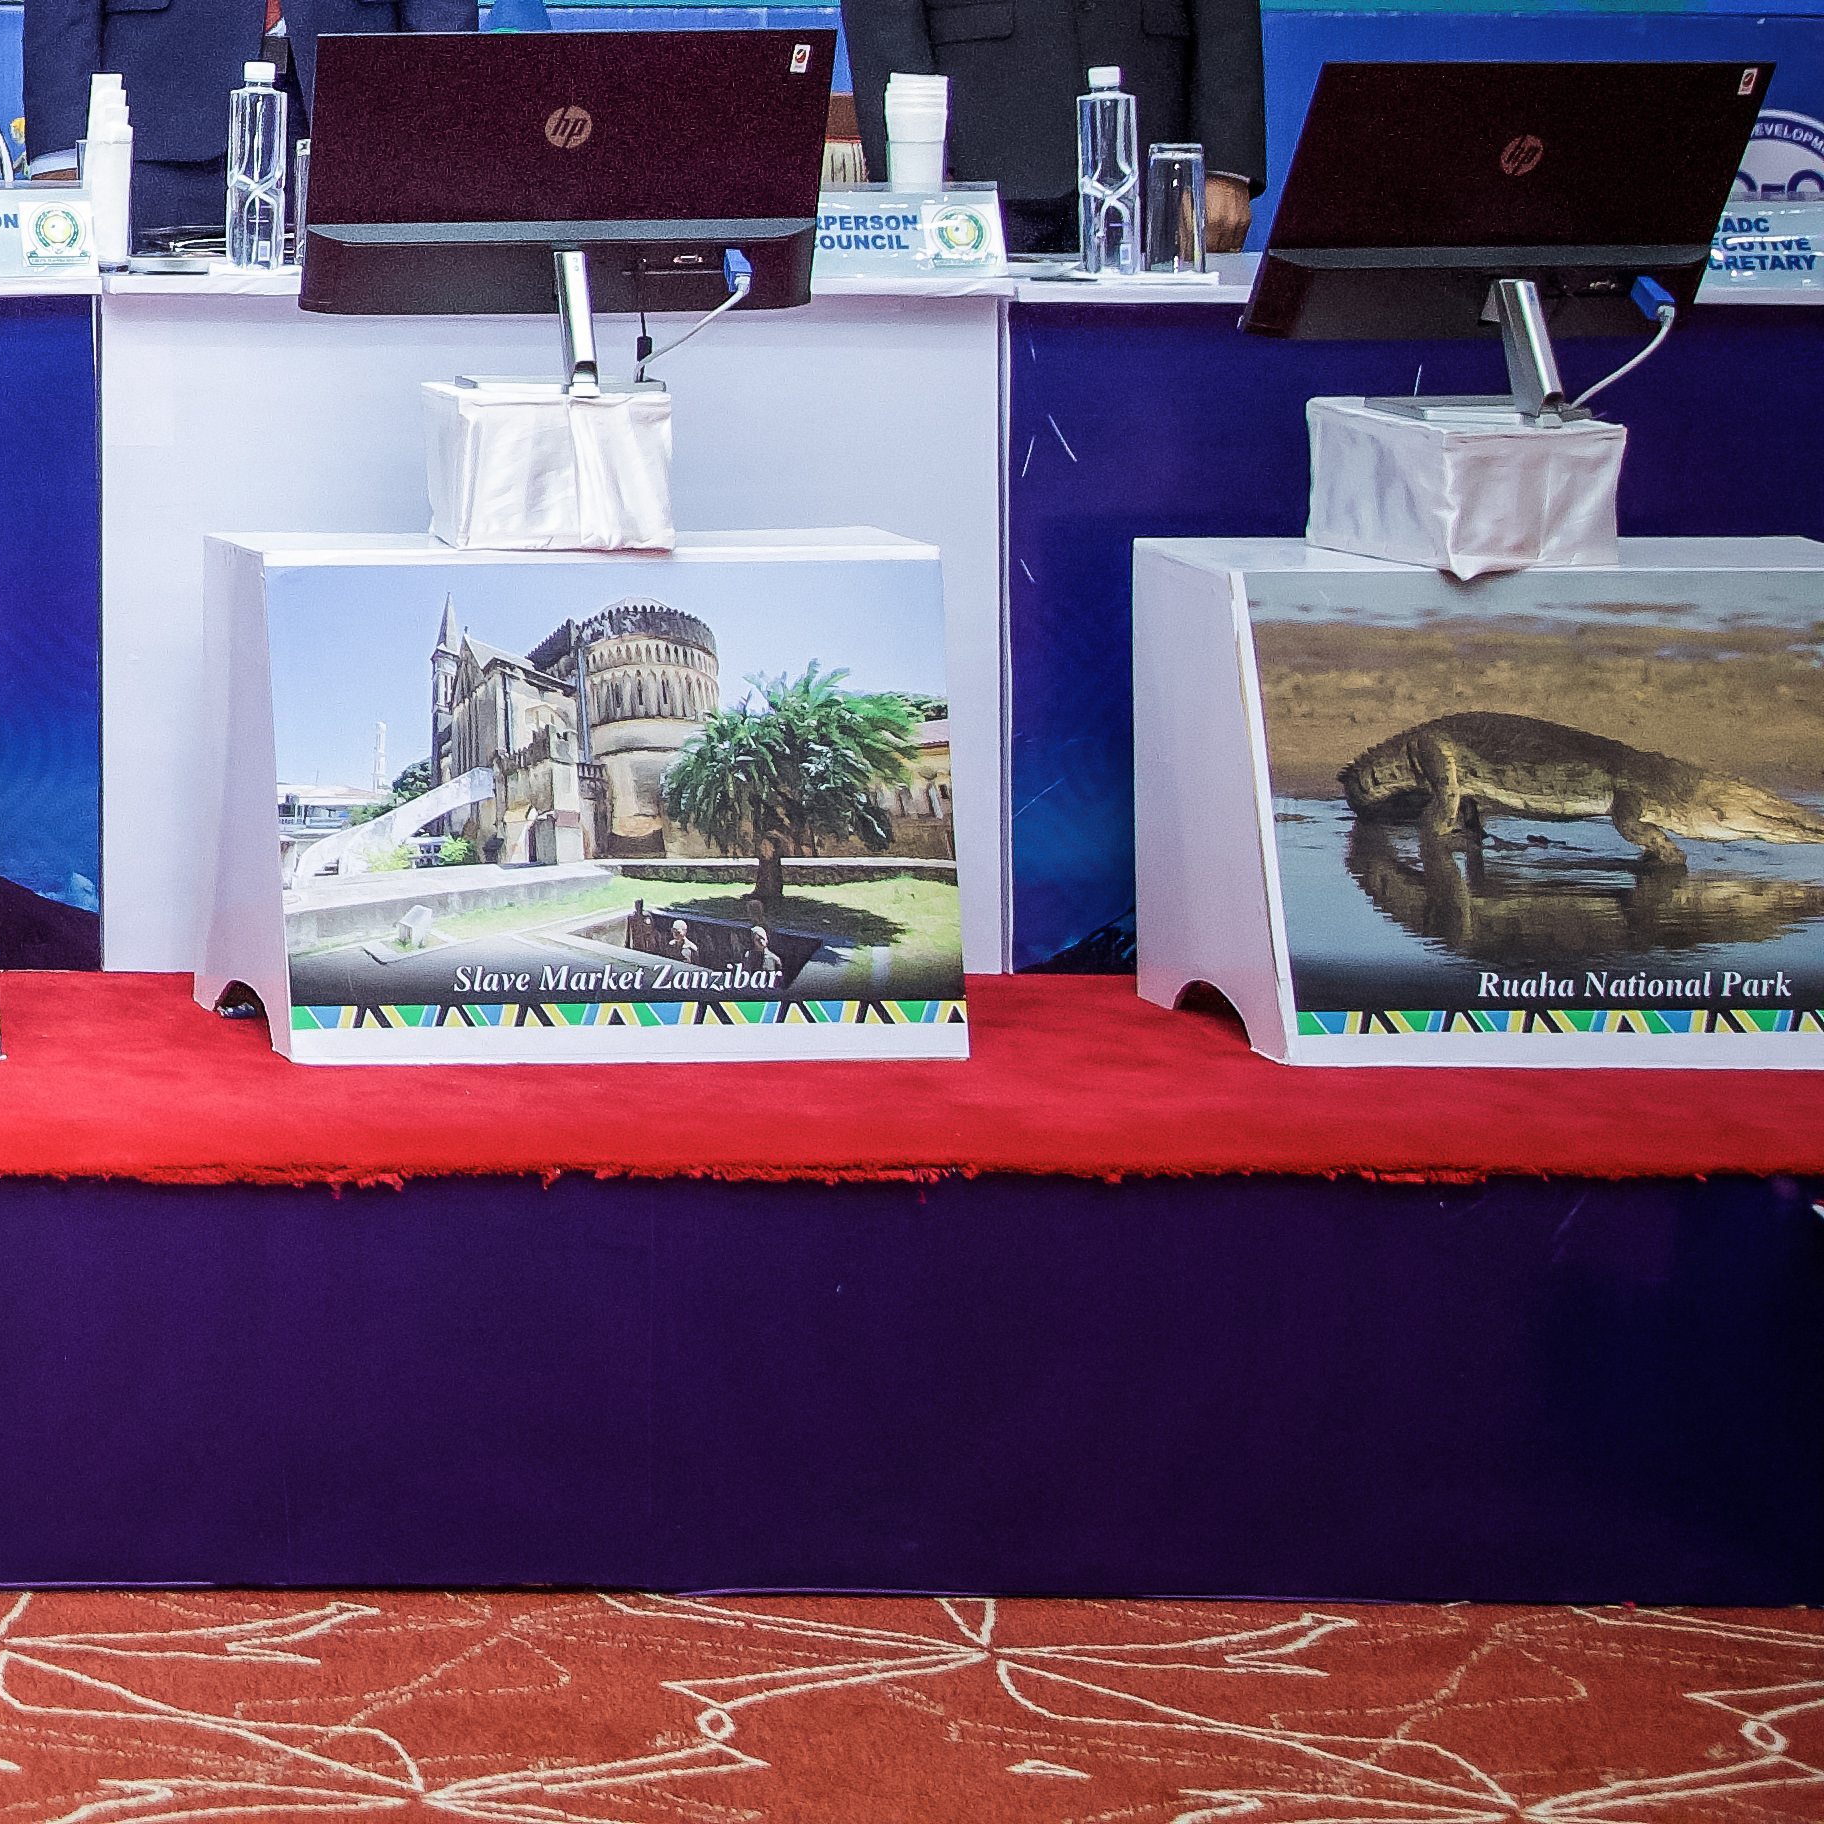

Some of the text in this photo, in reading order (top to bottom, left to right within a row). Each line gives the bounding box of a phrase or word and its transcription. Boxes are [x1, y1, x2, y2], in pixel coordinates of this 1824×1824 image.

[549, 105, 589, 148] hp
[1754, 122, 1824, 155] EVELOPM
[815, 234, 910, 251] OUNCIL
[453, 962, 784, 993] Slave Market Zanzibar
[1477, 971, 1793, 998] Ruaha National Park
